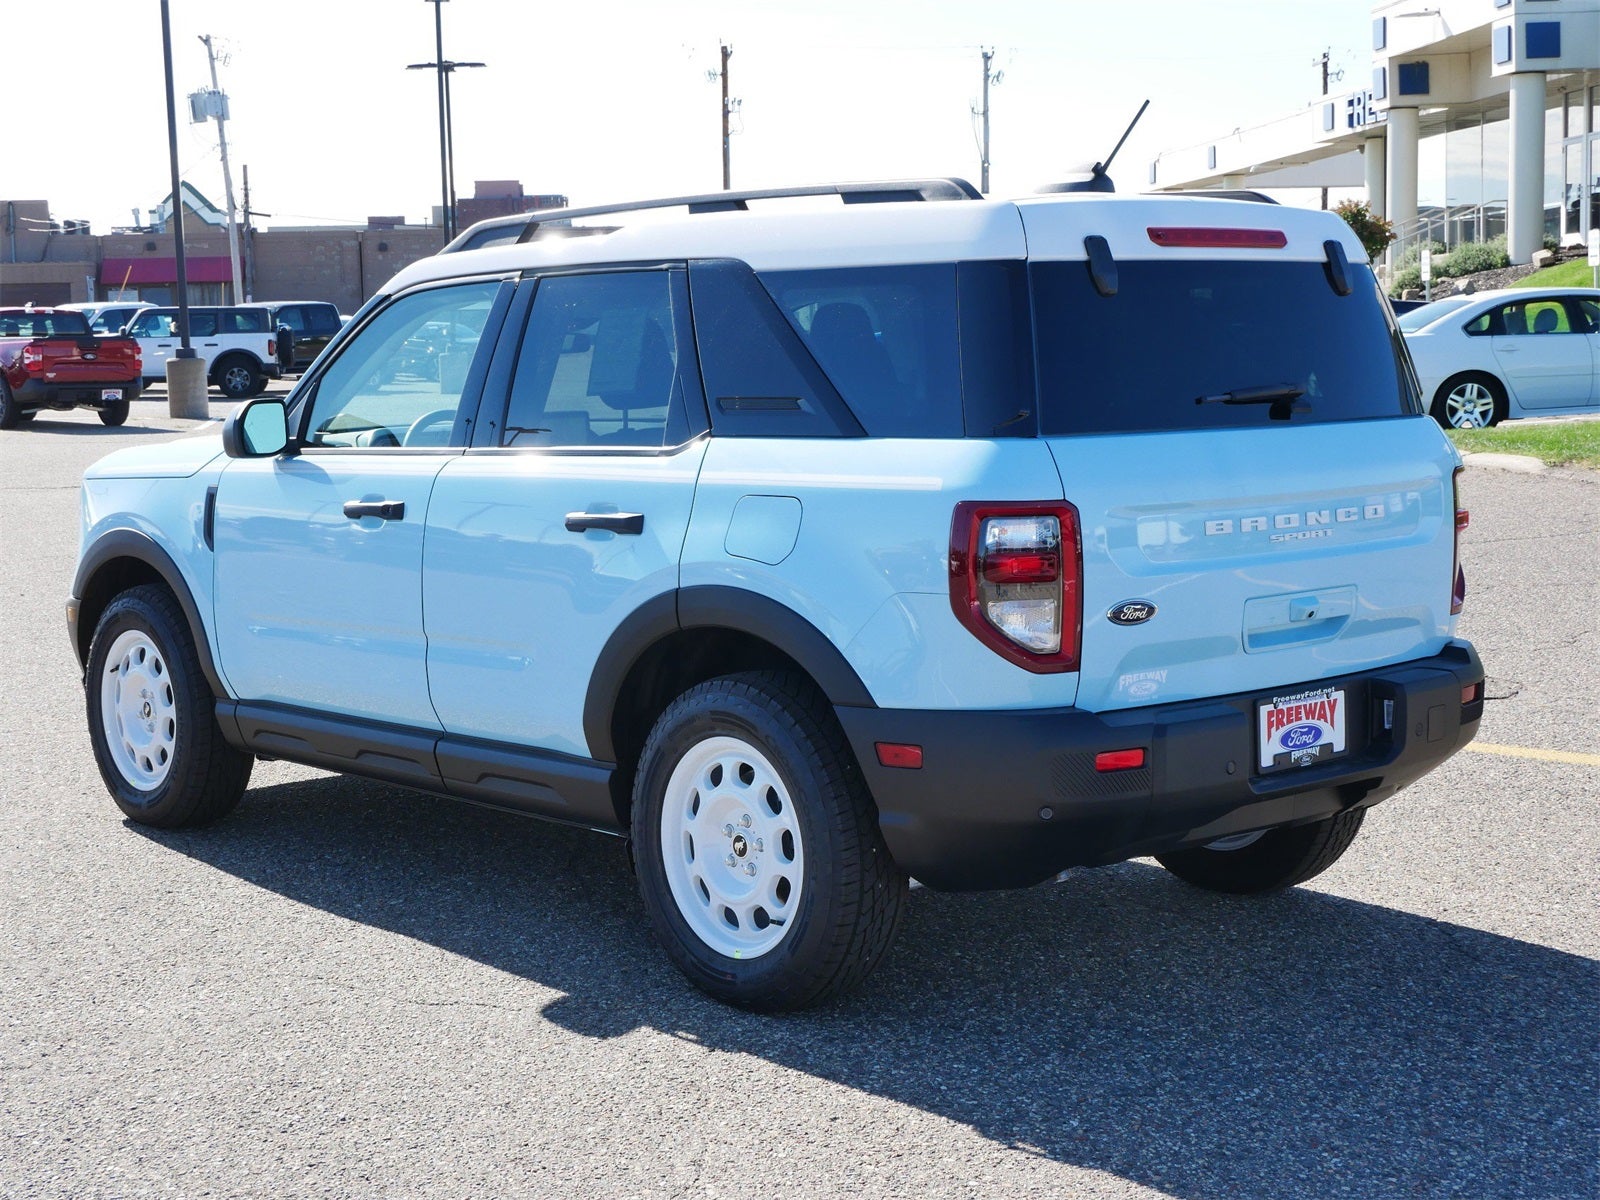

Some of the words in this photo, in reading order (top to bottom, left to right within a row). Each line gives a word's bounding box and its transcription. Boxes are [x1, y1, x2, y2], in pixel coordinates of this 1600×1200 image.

[1205, 504, 1385, 536] BRONCO
[1269, 528, 1335, 544] SPORT
[1120, 605, 1148, 620] Ford
[1119, 669, 1169, 691] FREEWAY
[1272, 686, 1335, 704] FreewayFord.net
[1266, 698, 1338, 744] FREEWAY
[1287, 728, 1316, 747] Ford
[1291, 746, 1320, 763] FREEWAY
